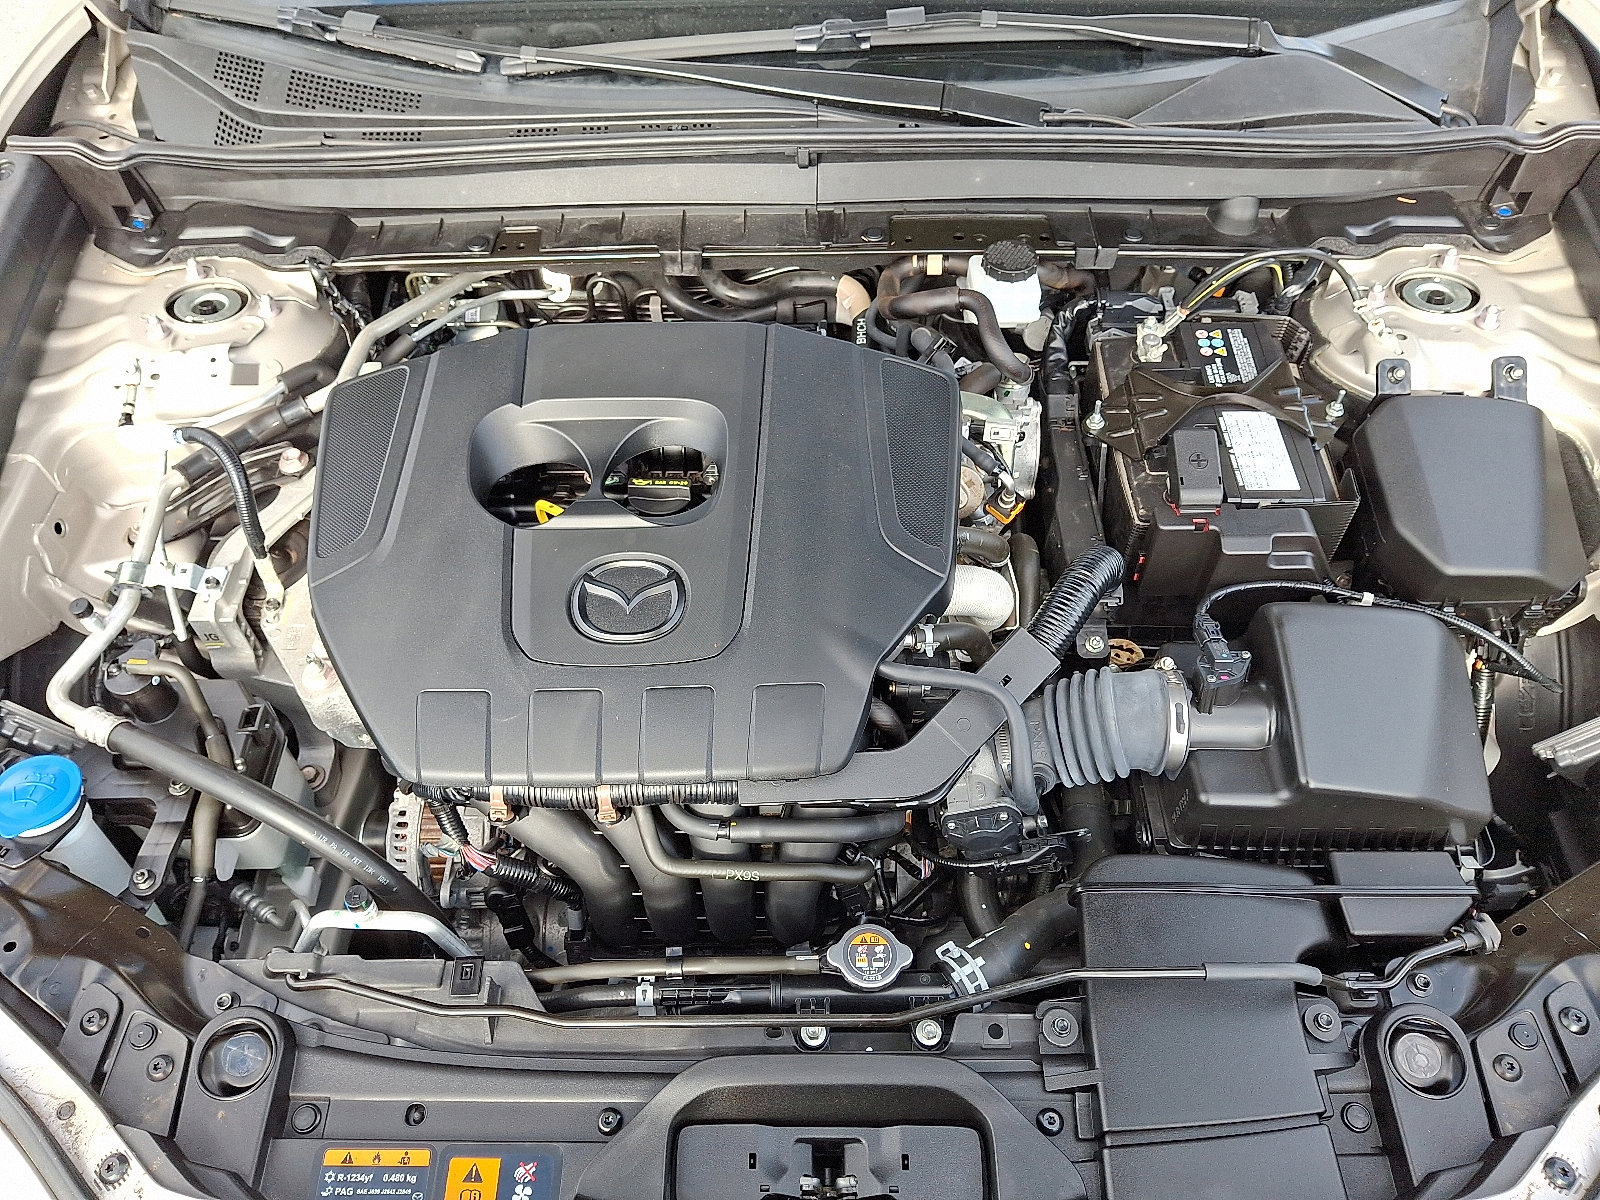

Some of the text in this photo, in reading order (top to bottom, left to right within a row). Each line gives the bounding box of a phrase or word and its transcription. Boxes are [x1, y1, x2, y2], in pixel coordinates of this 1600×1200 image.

[856, 318, 867, 345] BHCH
[725, 869, 760, 881] PX9S
[337, 1173, 418, 1184] R-1234yf 0.480 kg
[334, 1187, 354, 1196] PAG
